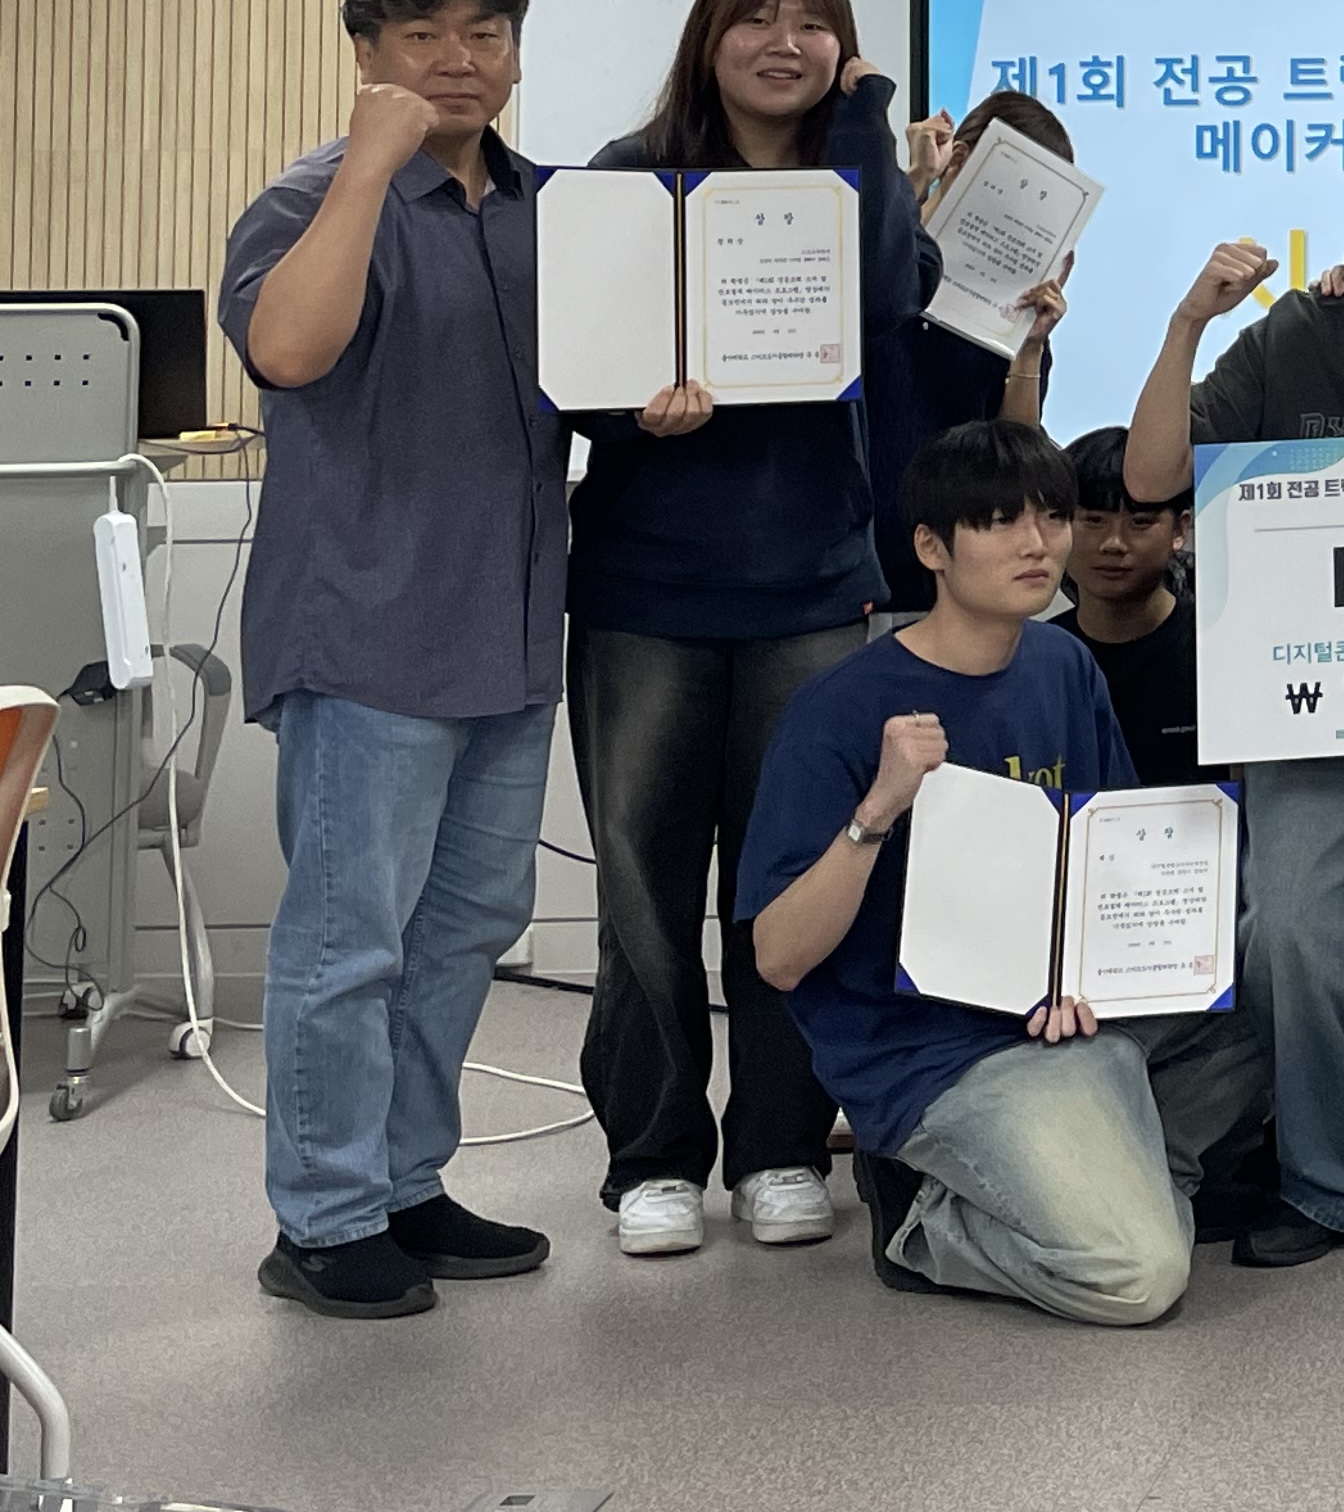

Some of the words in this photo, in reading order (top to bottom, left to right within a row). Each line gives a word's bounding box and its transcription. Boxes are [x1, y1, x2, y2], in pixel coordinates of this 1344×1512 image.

[991, 54, 1125, 108] 제1회
[1153, 54, 1259, 106] 전공
[1239, 483, 1282, 501] 제1회
[1287, 481, 1320, 498] 전공
